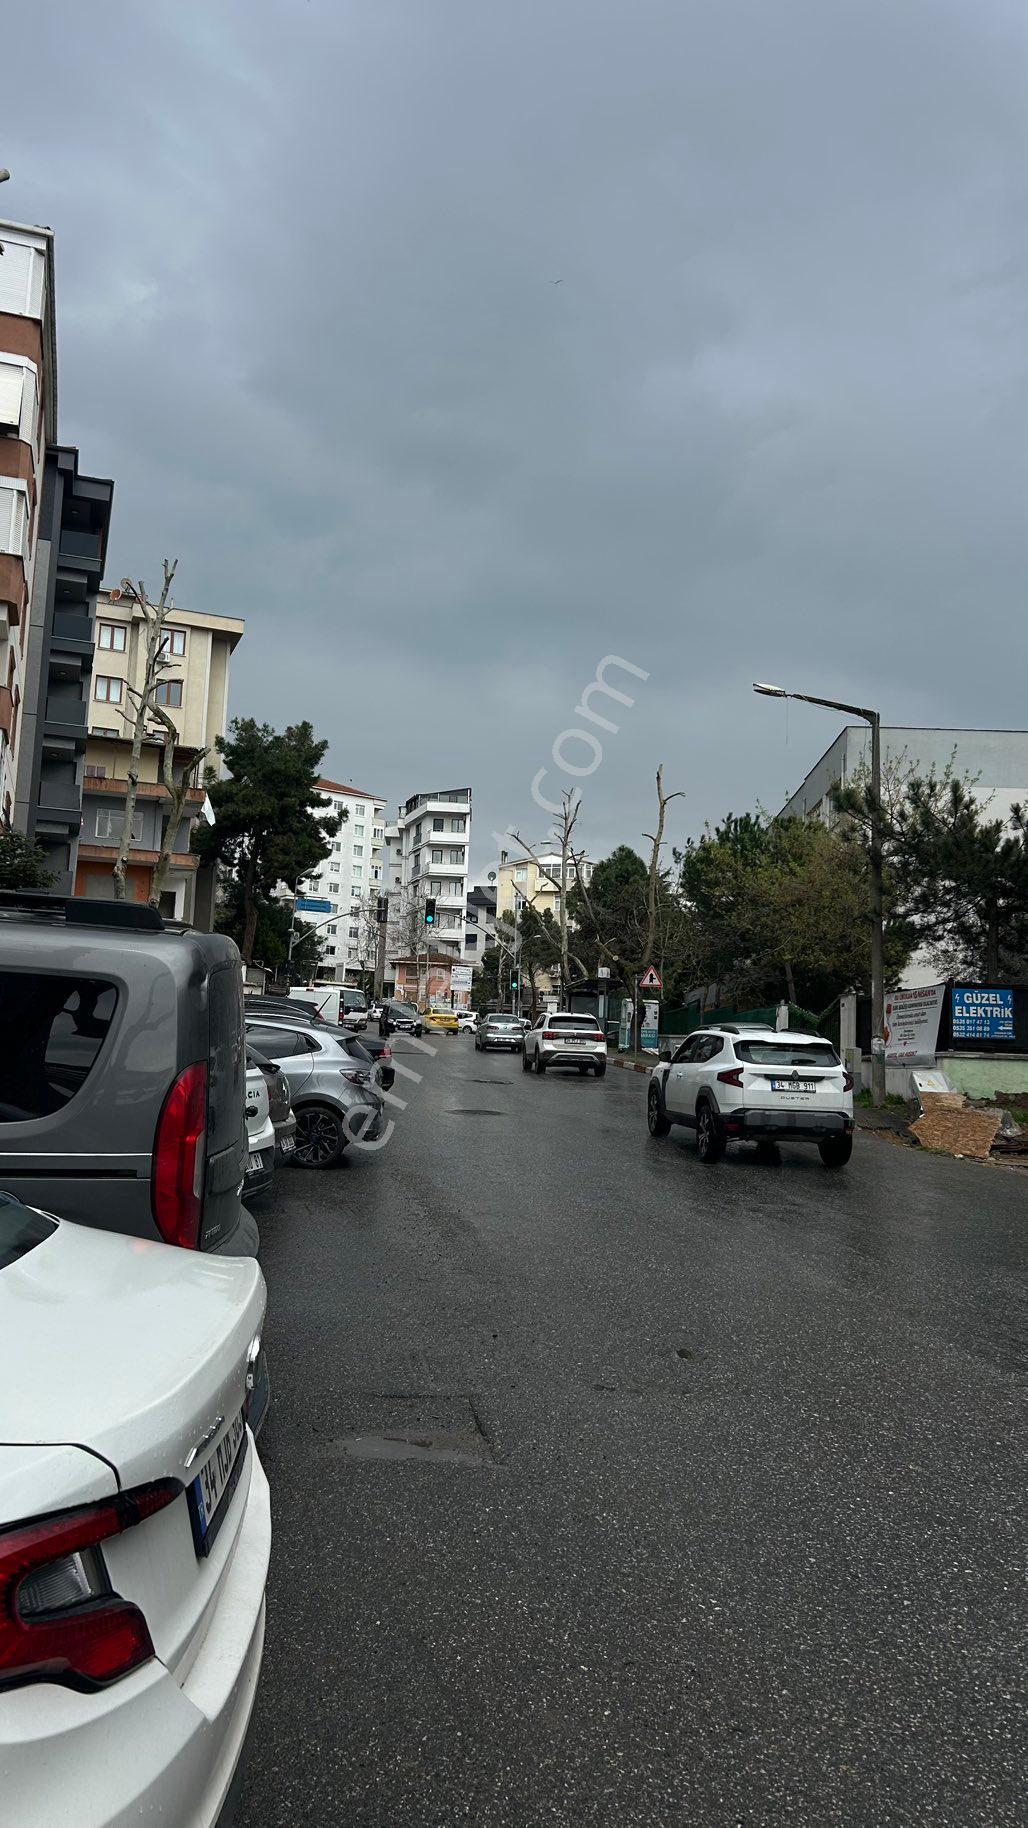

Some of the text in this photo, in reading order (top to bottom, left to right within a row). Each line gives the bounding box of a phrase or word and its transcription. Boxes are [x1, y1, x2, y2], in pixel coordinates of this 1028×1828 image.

[963, 990, 1004, 1004] GÜZEL
[803, 1082, 814, 1090] 911
[245, 1090, 260, 1099] CIA
